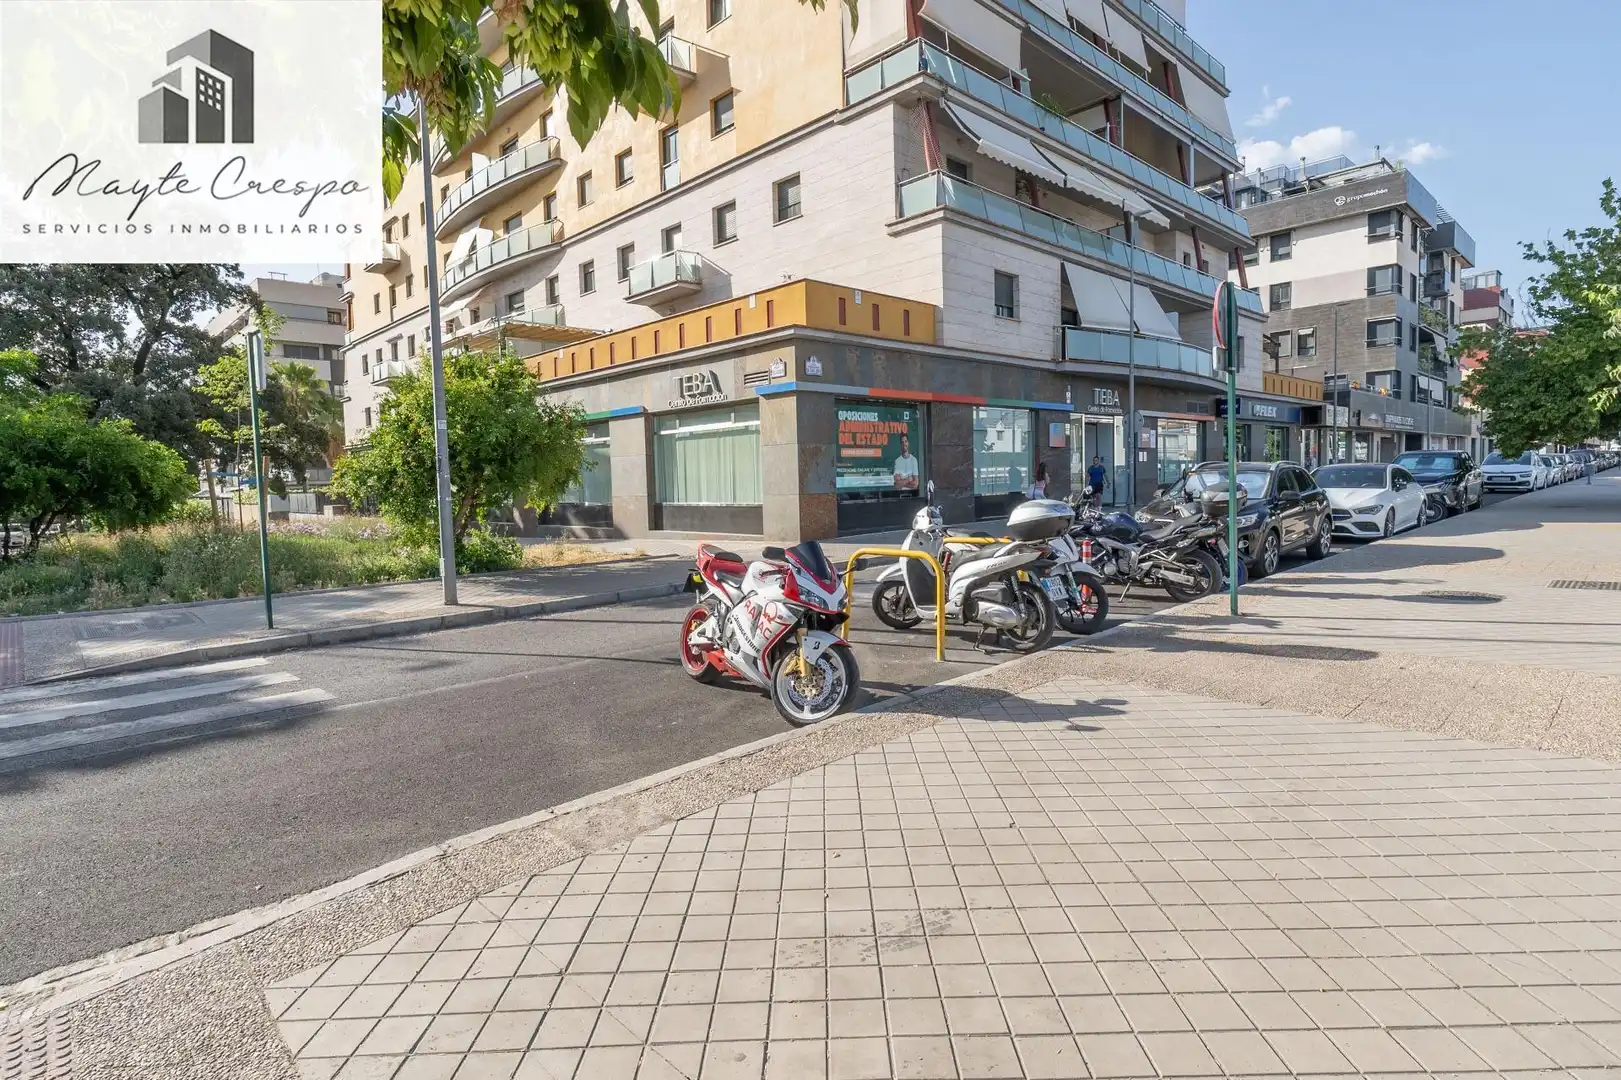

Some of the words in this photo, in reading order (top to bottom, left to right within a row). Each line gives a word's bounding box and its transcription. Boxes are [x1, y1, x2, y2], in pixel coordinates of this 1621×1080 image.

[672, 369, 716, 398] TEBA
[1093, 388, 1120, 405] TEBA
[838, 411, 878, 421] OPOSICIONES
[839, 420, 908, 433] ADMINISTRATIVO
[838, 432, 854, 445] DEL
[856, 433, 889, 446] ESTADO
